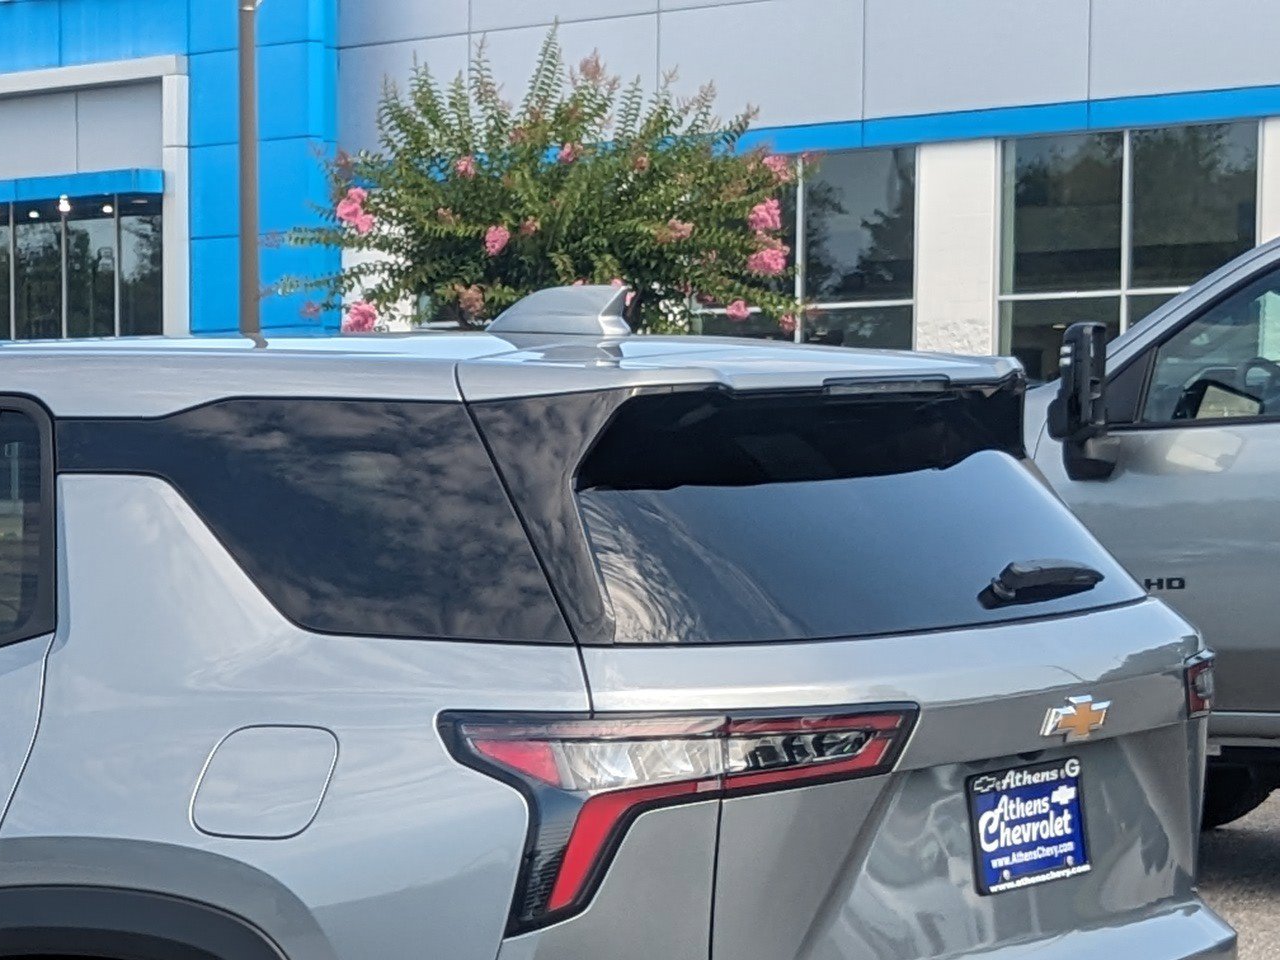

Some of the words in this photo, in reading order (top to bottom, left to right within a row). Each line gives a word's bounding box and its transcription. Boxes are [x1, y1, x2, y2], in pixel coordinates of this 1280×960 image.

[1144, 577, 1186, 591] HD
[1001, 769, 1059, 790] Athens
[1064, 758, 1080, 777] G
[997, 794, 1050, 821] Athens
[978, 809, 1072, 852] Chevrolet
